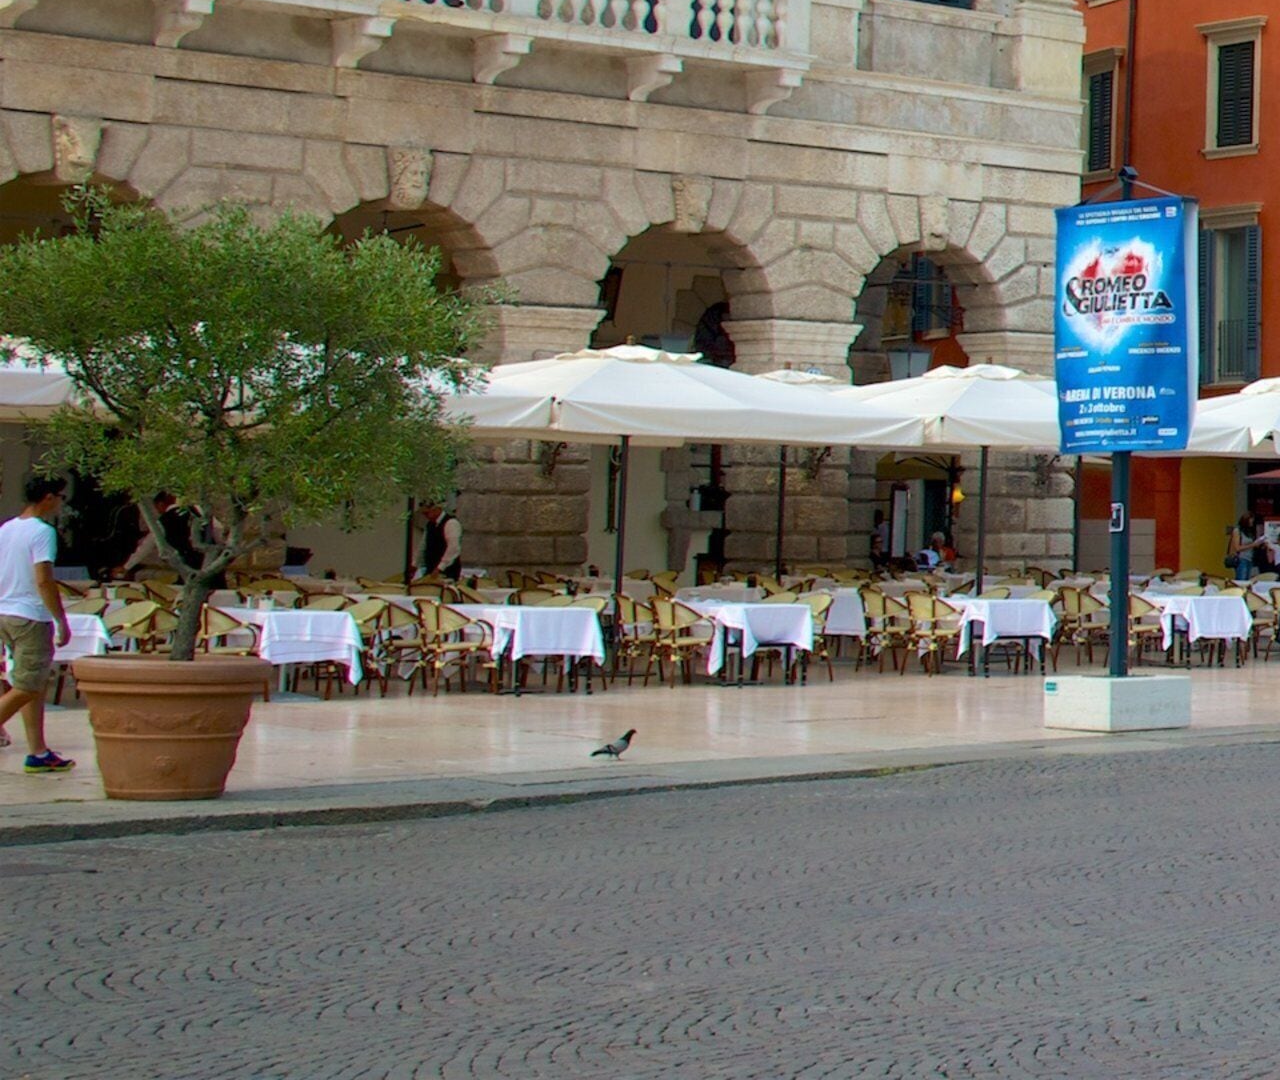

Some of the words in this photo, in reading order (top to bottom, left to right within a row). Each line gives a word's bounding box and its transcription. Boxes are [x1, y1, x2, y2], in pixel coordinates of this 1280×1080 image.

[1081, 274, 1147, 296] ROMEO
[1077, 291, 1173, 315] GIULIETTA
[1065, 388, 1091, 402] ARENA
[1092, 387, 1101, 400] DI
[1102, 386, 1156, 400] VERONA
[1093, 402, 1126, 413] ottobre
